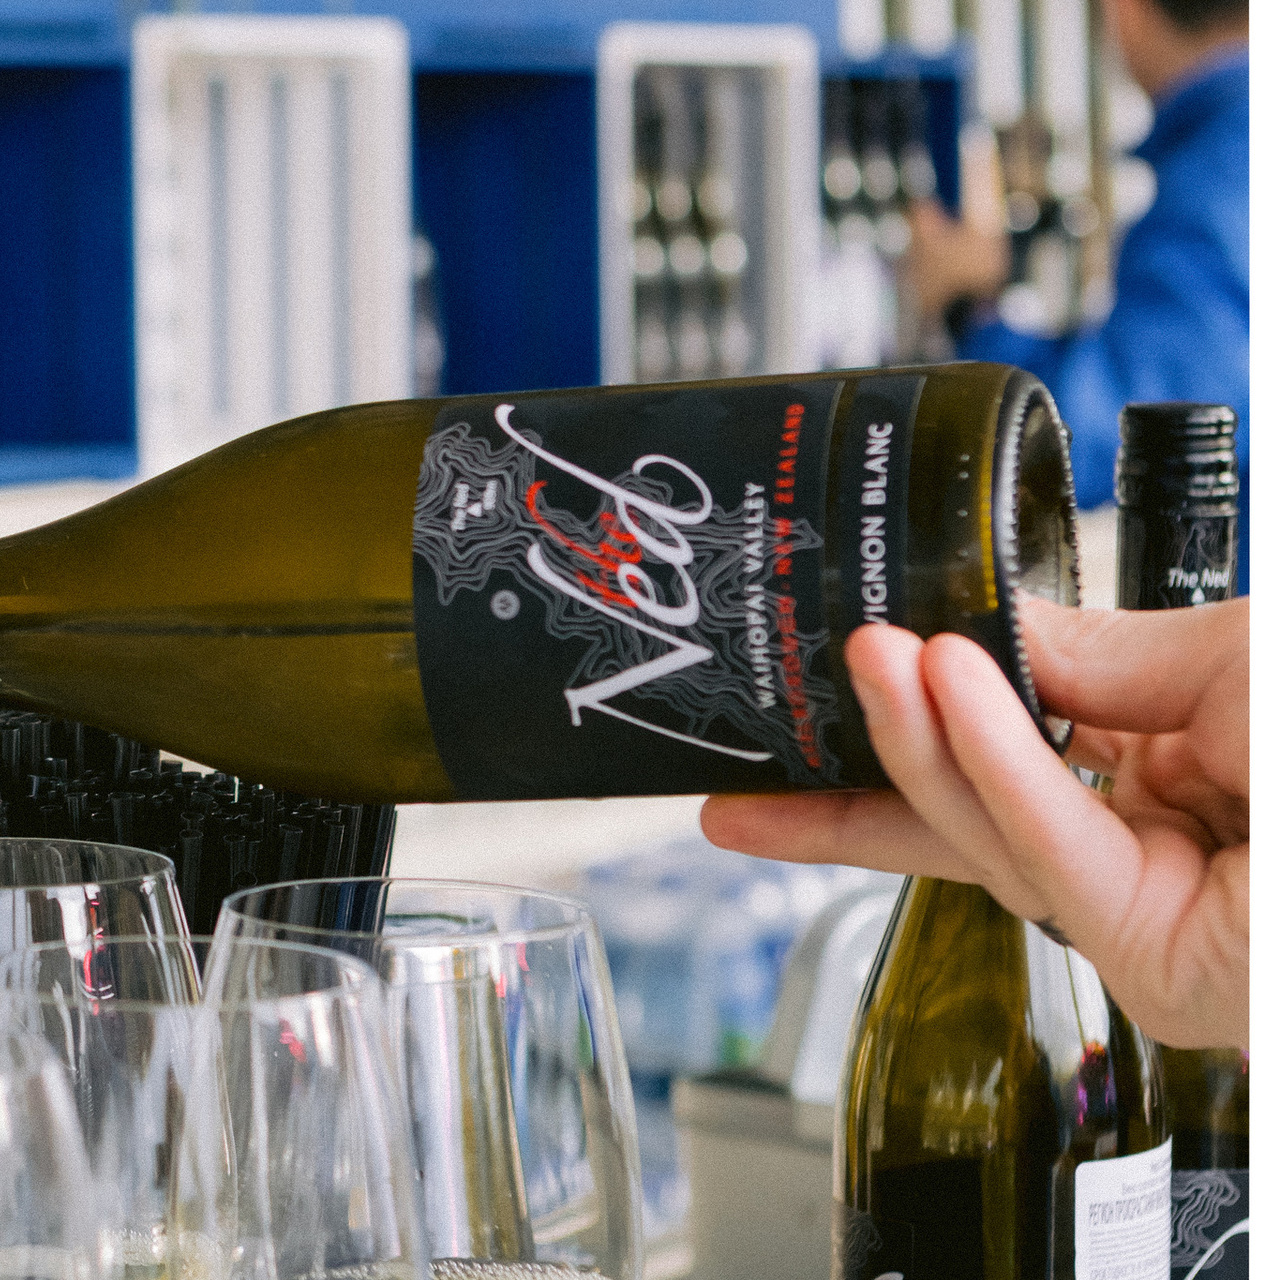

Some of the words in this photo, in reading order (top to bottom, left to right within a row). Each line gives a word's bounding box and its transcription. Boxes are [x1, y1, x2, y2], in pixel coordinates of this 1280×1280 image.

[773, 403, 805, 505] ZEALAND
[861, 422, 894, 507] BLANC
[743, 481, 766, 573] VALLEY
[772, 517, 794, 576] NEW
[494, 403, 775, 762] Ned
[1168, 567, 1199, 589] The
[1200, 567, 1230, 589] Ned
[744, 583, 778, 709] WAIHOPAI
